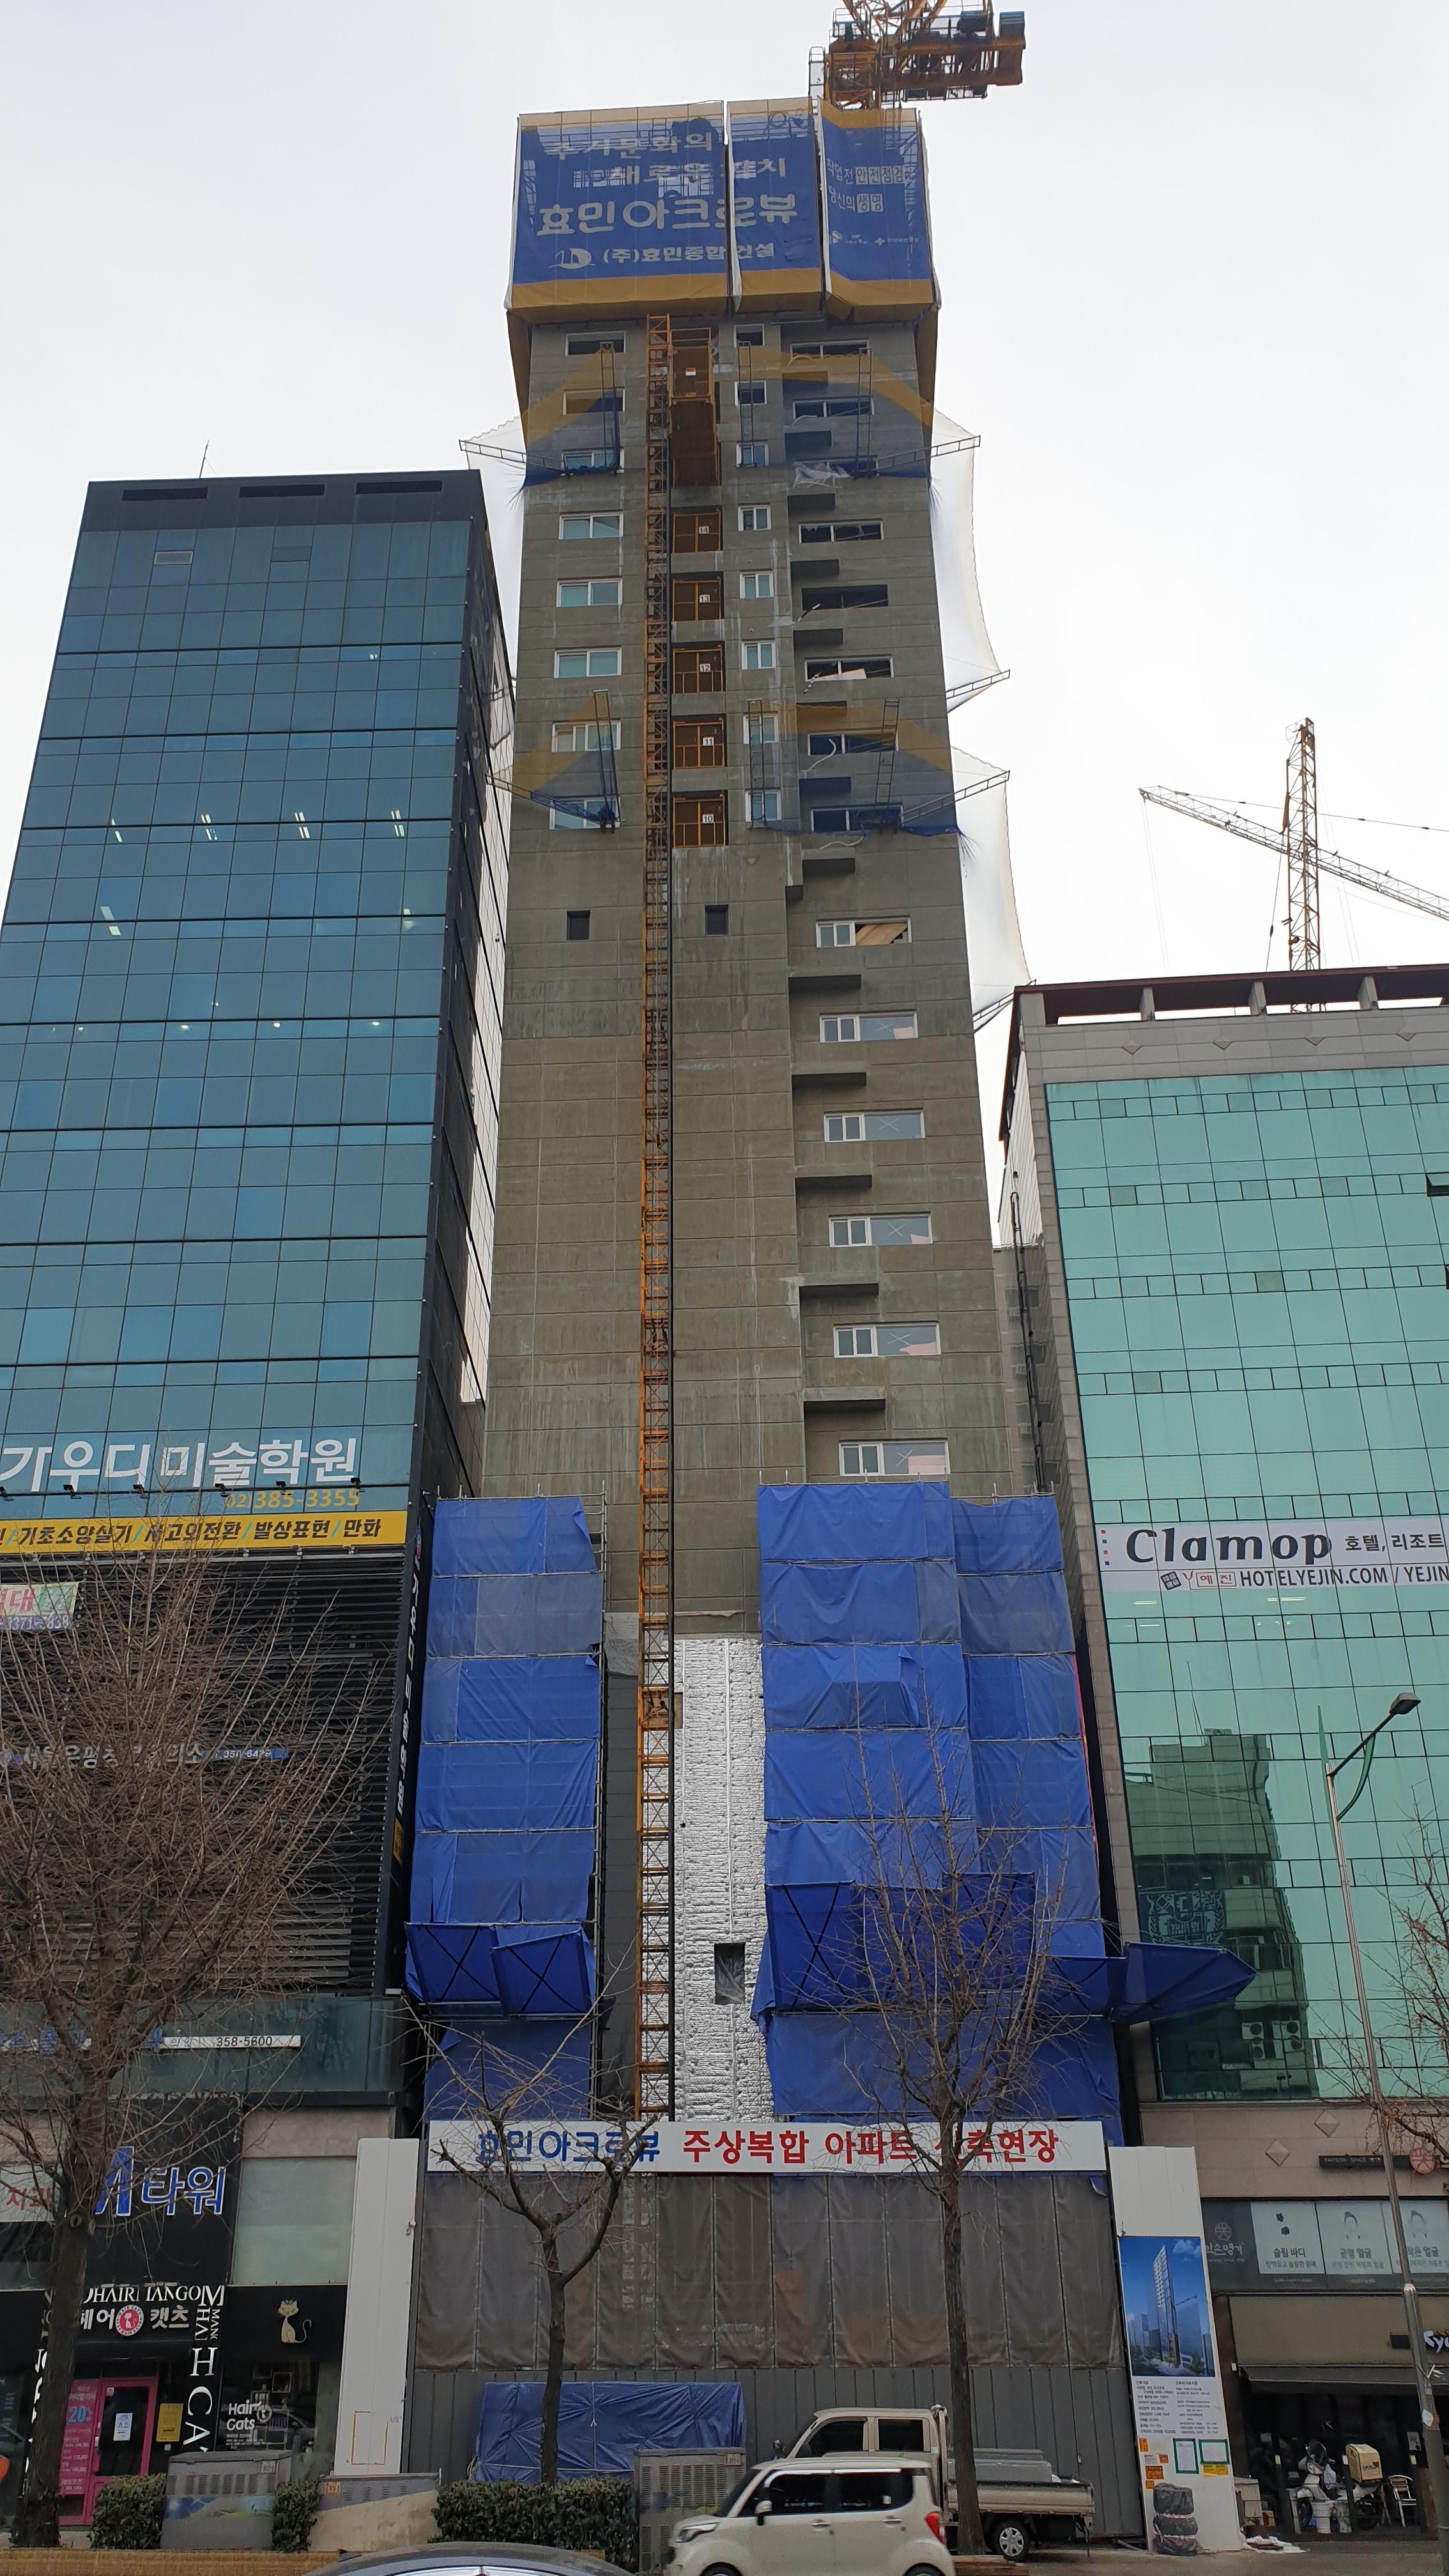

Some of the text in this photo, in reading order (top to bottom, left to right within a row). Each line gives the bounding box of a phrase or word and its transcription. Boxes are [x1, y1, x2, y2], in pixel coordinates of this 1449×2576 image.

[857, 194, 883, 213] 생명
[537, 194, 797, 236] 효민아크로뷰
[226, 1489, 360, 1509] 02)385-3355
[17, 1525, 133, 1545] 기초소양실기
[254, 1520, 330, 1540] 발상표현
[342, 1519, 382, 1538] 만화
[1126, 1527, 1445, 1565] Clamop 호텔, 리조트
[1240, 1567, 1388, 1587] HOTELYEJIN.COM
[216, 2035, 273, 2048] 358-5600
[683, 2130, 809, 2165] 주상복합
[825, 2130, 917, 2165] 아파트
[150, 2305, 190, 2329] 캣츠
[228, 2399, 262, 2416] Hair
[226, 2417, 256, 2431] Cats
